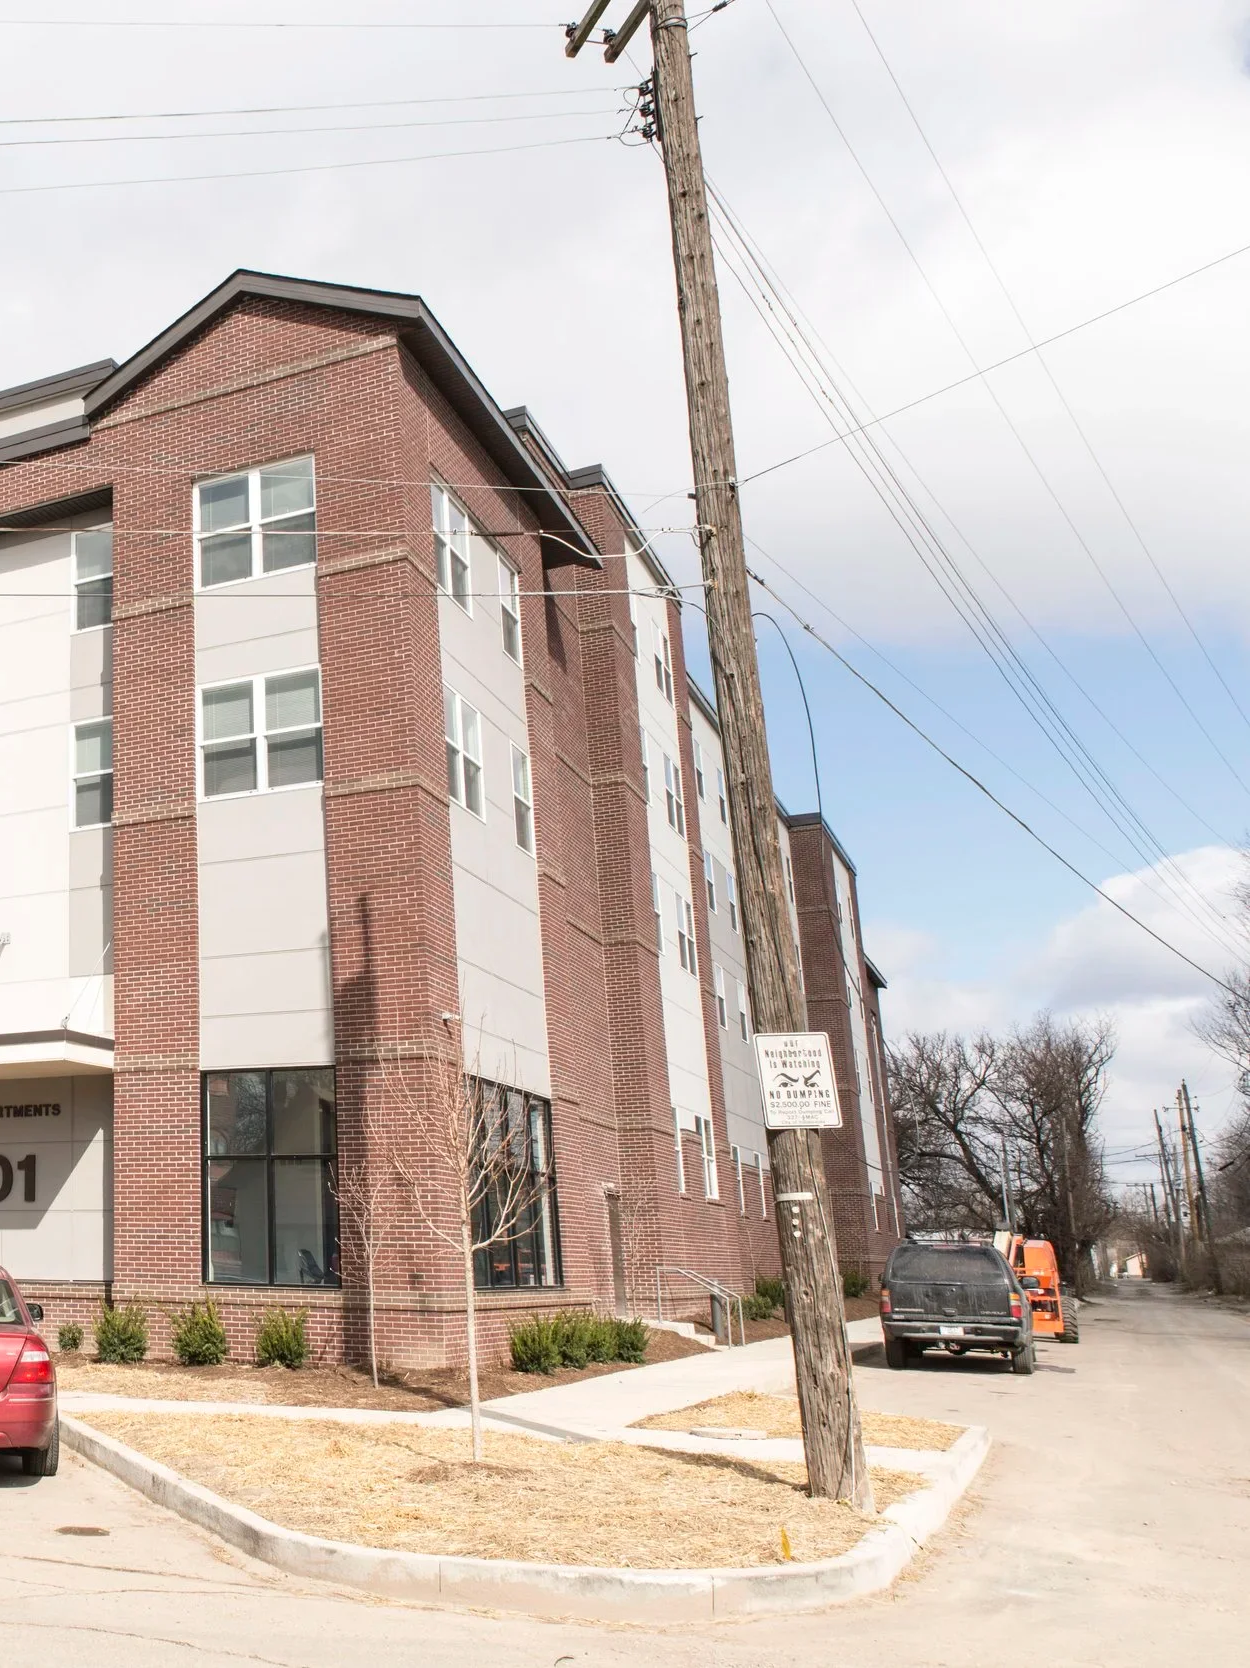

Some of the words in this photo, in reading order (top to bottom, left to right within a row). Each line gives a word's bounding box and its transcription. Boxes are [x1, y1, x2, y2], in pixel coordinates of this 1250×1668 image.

[781, 1060, 821, 1069] Watching
[769, 1090, 781, 1099] NO
[787, 1089, 830, 1099] DUMPING
[814, 1100, 831, 1108] FINE
